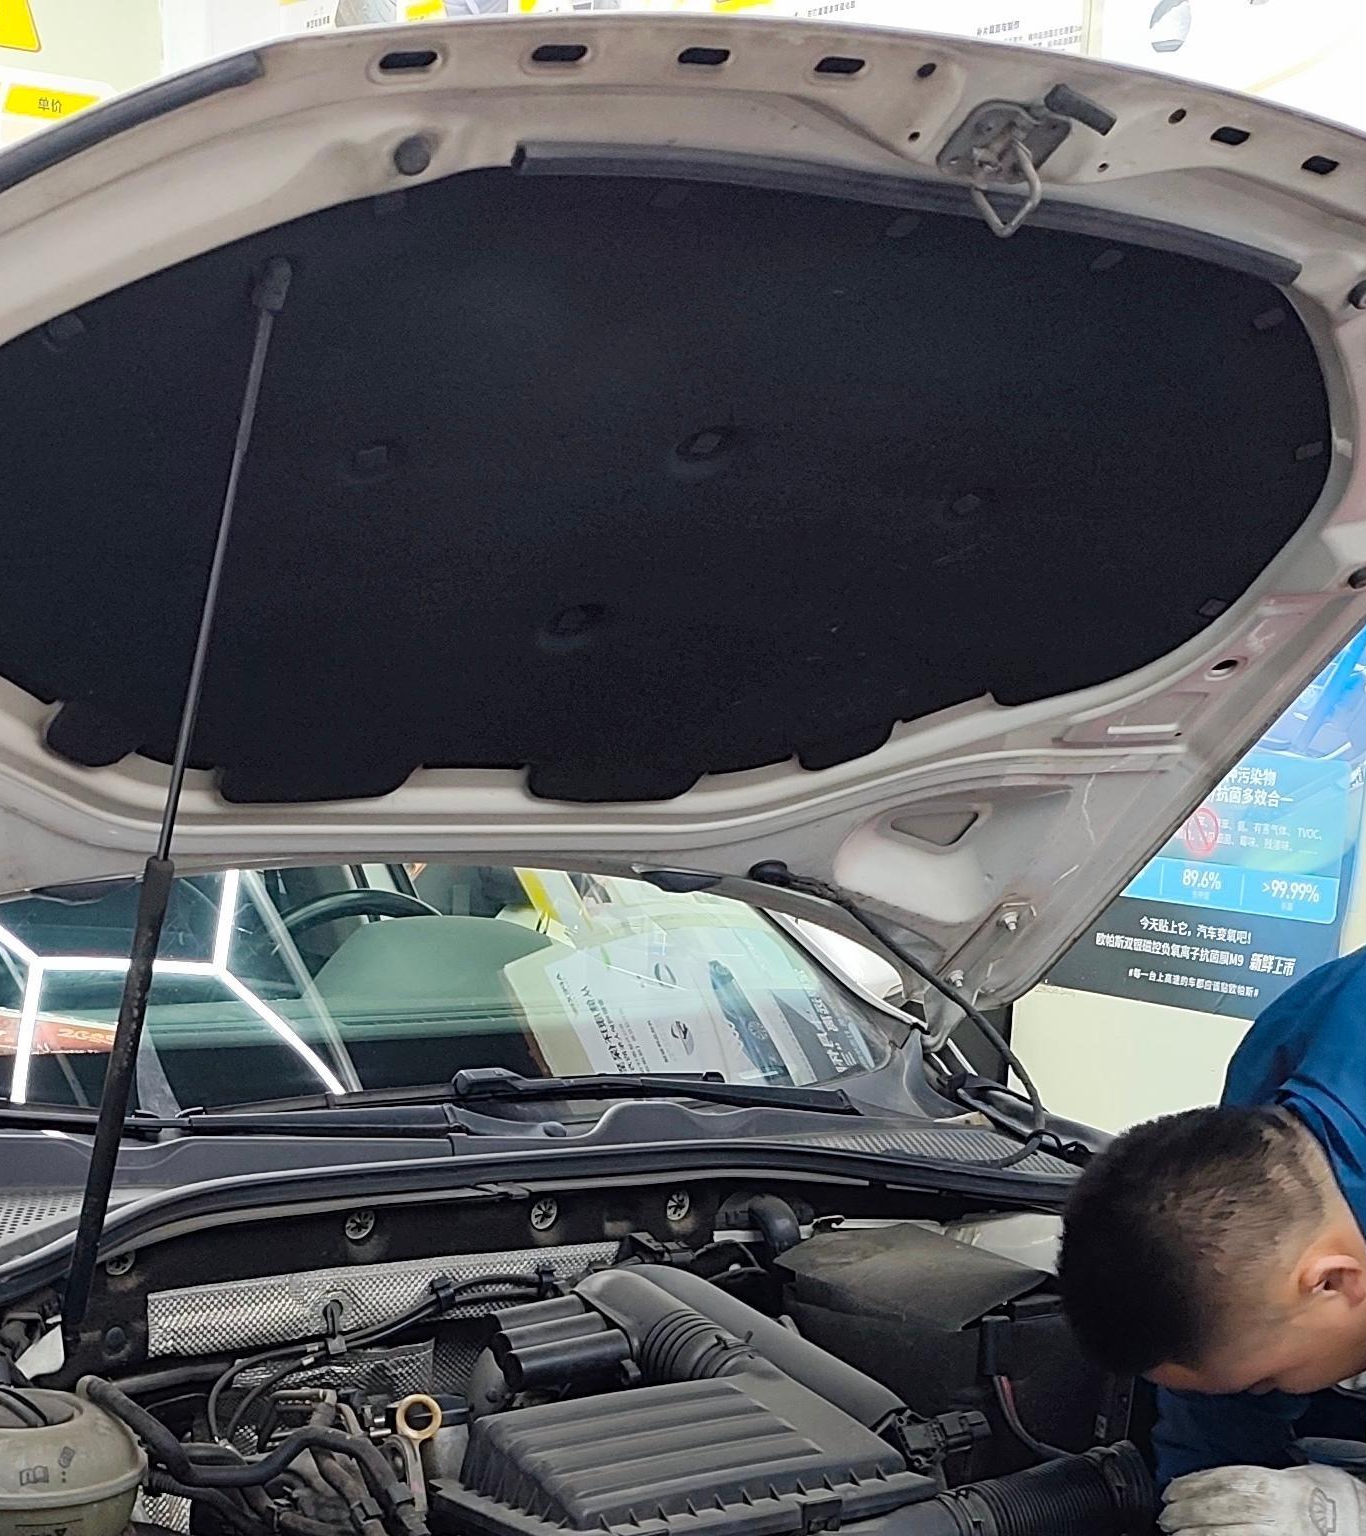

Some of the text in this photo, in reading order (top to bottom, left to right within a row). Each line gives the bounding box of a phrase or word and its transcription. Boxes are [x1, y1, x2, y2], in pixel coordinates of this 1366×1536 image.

[38, 97, 62, 113] 单价
[1182, 868, 1222, 891] 89.6%
[1262, 879, 1320, 904] >99.99%
